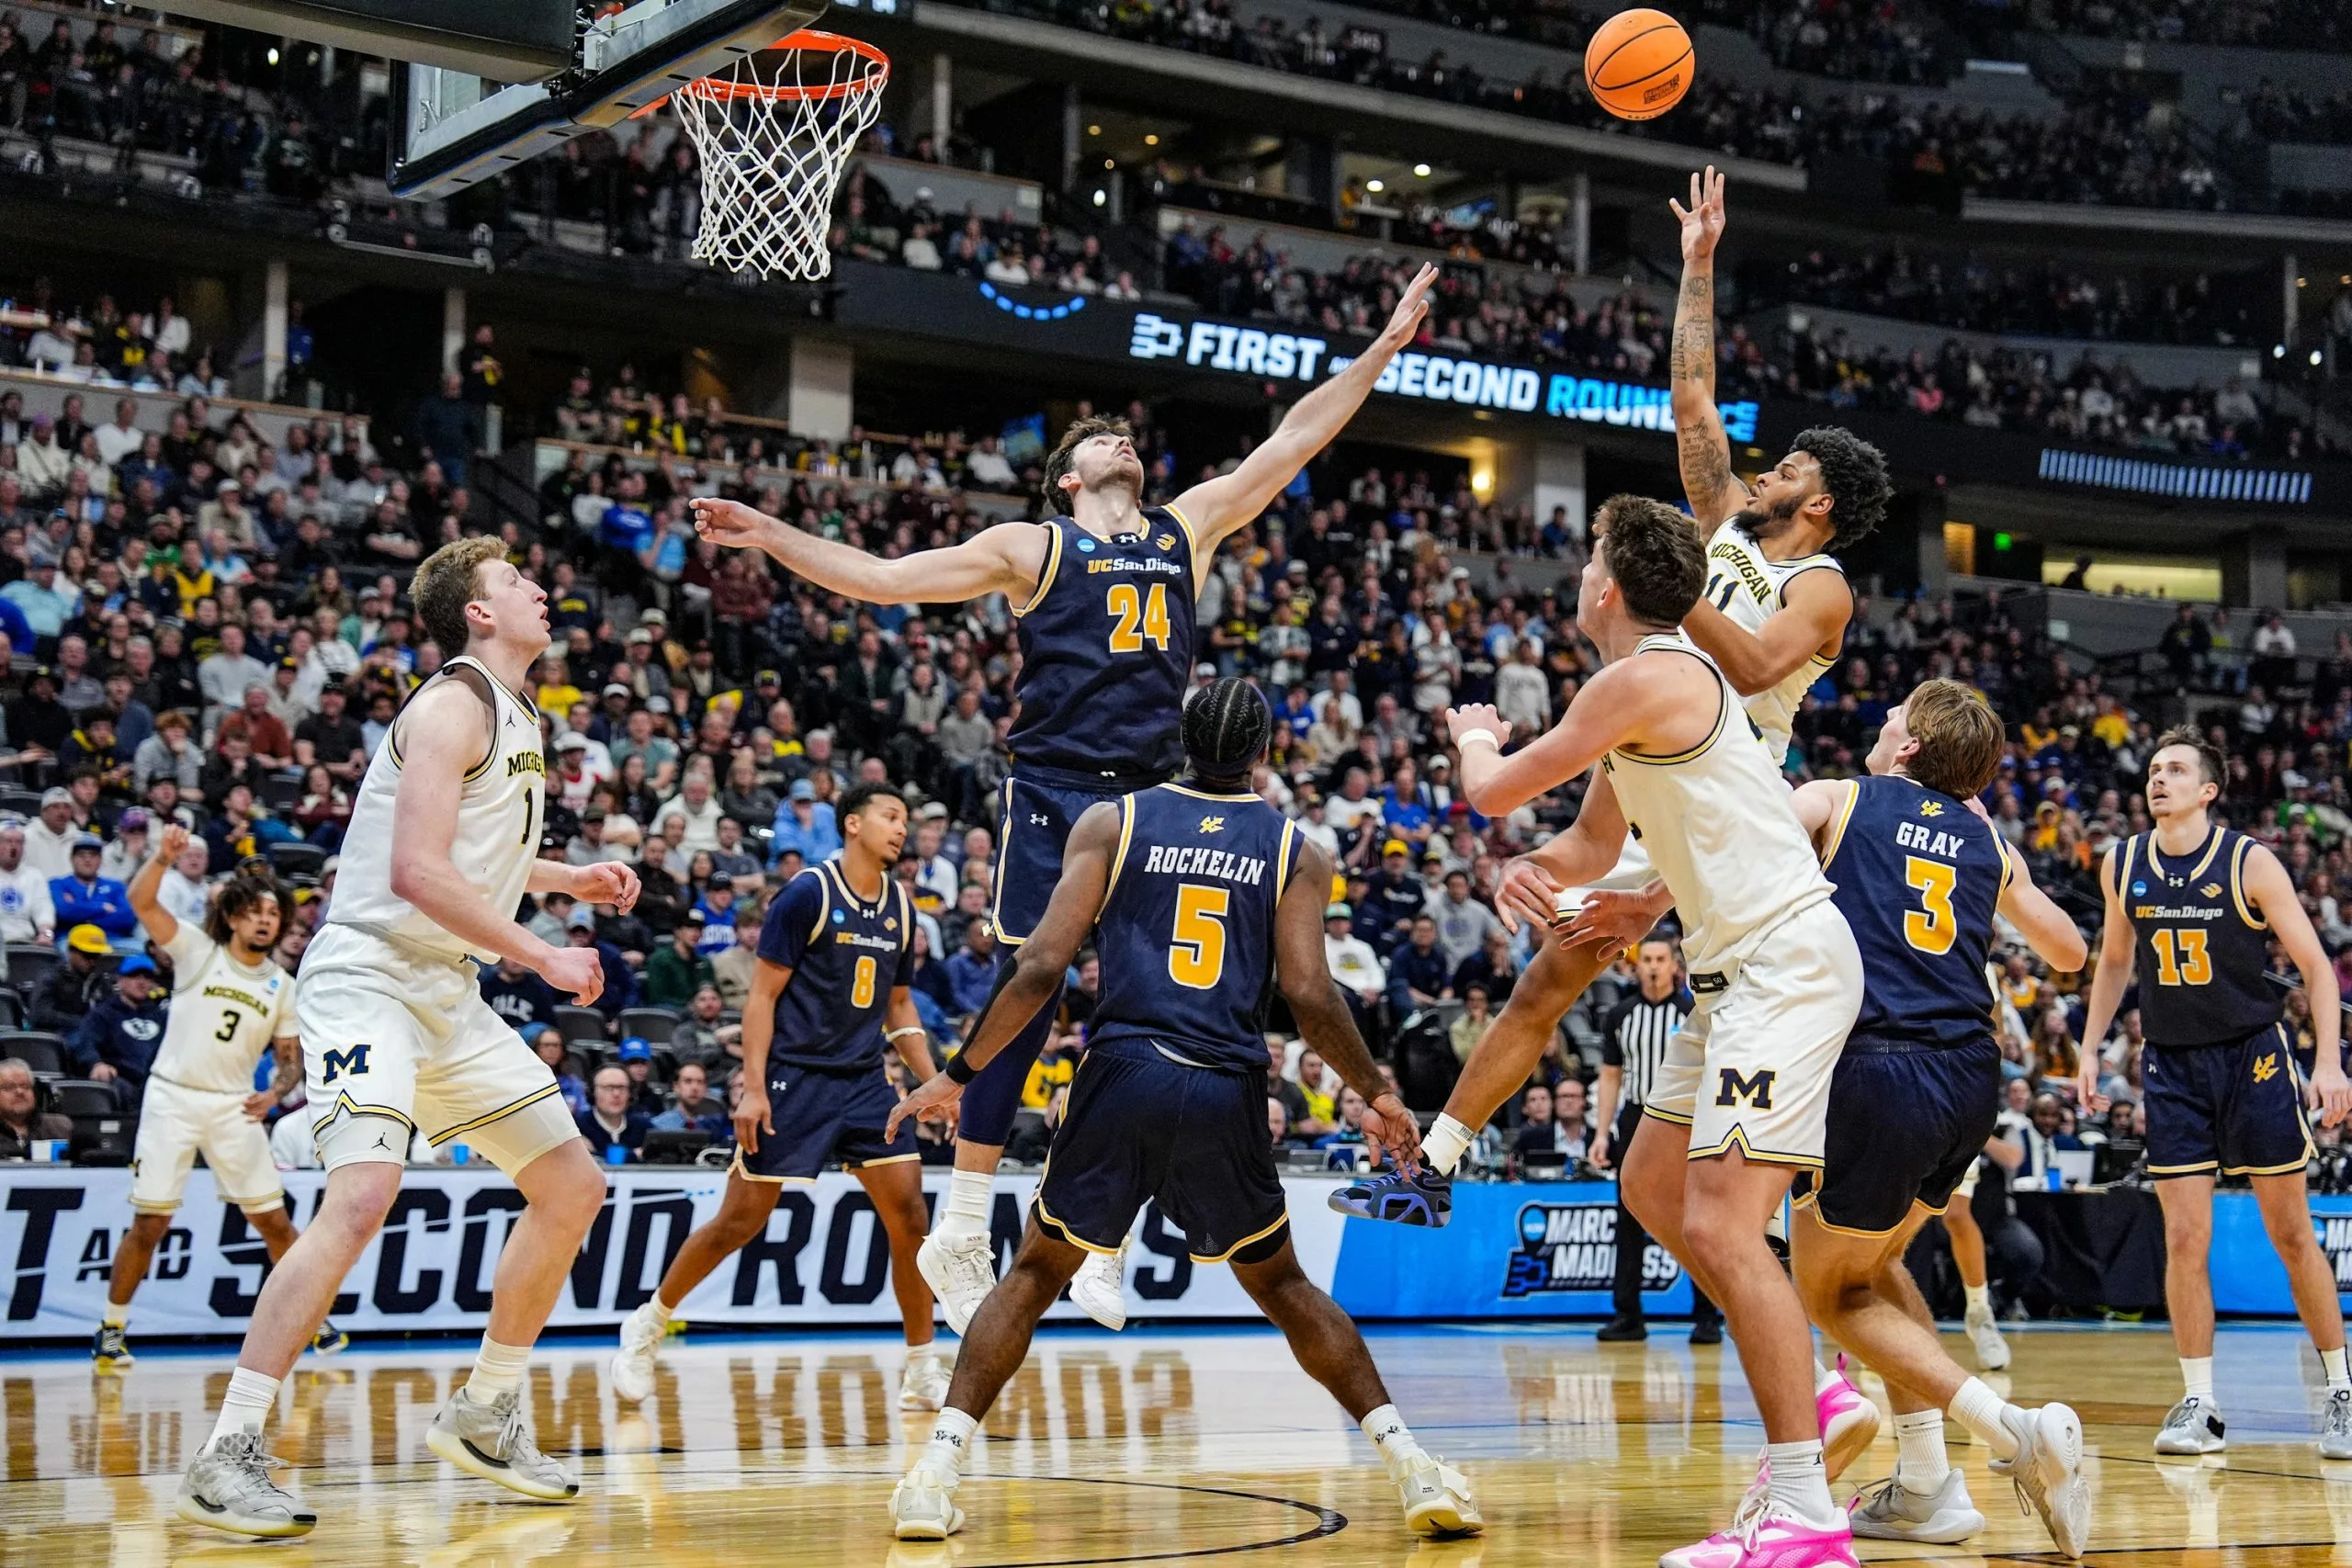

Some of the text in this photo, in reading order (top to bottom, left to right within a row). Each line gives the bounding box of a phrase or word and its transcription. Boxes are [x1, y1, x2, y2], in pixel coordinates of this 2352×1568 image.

[1186, 321, 1327, 381] FIRST
[1373, 352, 1540, 412] SECOND
[1546, 374, 1676, 434] ROUND
[1710, 543, 1772, 605] MICHIGAN
[1106, 582, 1171, 653] 24
[521, 786, 534, 845] 1
[1895, 821, 1965, 859] GRAY
[1144, 845, 1266, 886] ROCHELIN
[1903, 854, 1958, 956] 3
[1168, 883, 1231, 990] 5
[2150, 928, 2213, 987] 13
[851, 955, 876, 1009] 8
[214, 1009, 242, 1043] 3
[322, 1043, 372, 1087] M
[1714, 1067, 1777, 1111] M
[75, 1228, 193, 1281] AD
[209, 1187, 696, 1317] SCOND
[1545, 1208, 1619, 1244] MARC
